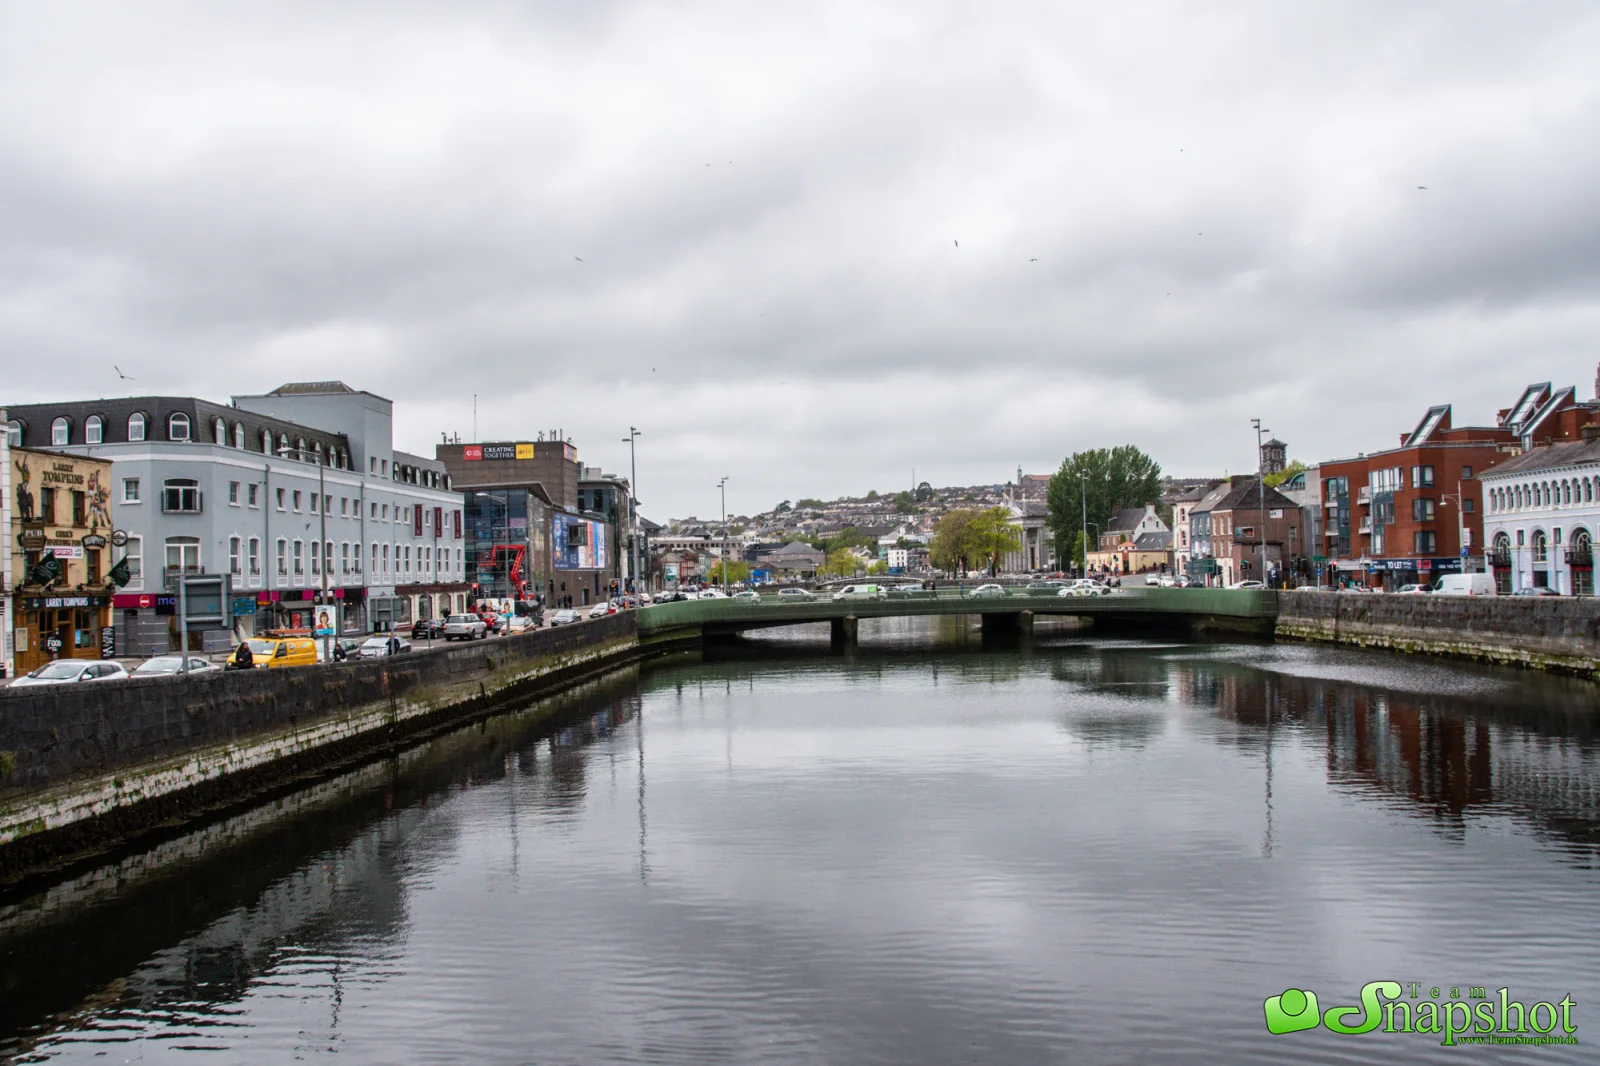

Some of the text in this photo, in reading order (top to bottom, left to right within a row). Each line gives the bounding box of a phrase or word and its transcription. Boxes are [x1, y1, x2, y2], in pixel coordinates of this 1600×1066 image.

[53, 463, 74, 472] LARRY
[43, 471, 84, 484] TOMPKINS
[1387, 561, 1393, 569] TO
[1394, 561, 1402, 569] LET
[46, 597, 88, 607] LARRY TOMPKINS
